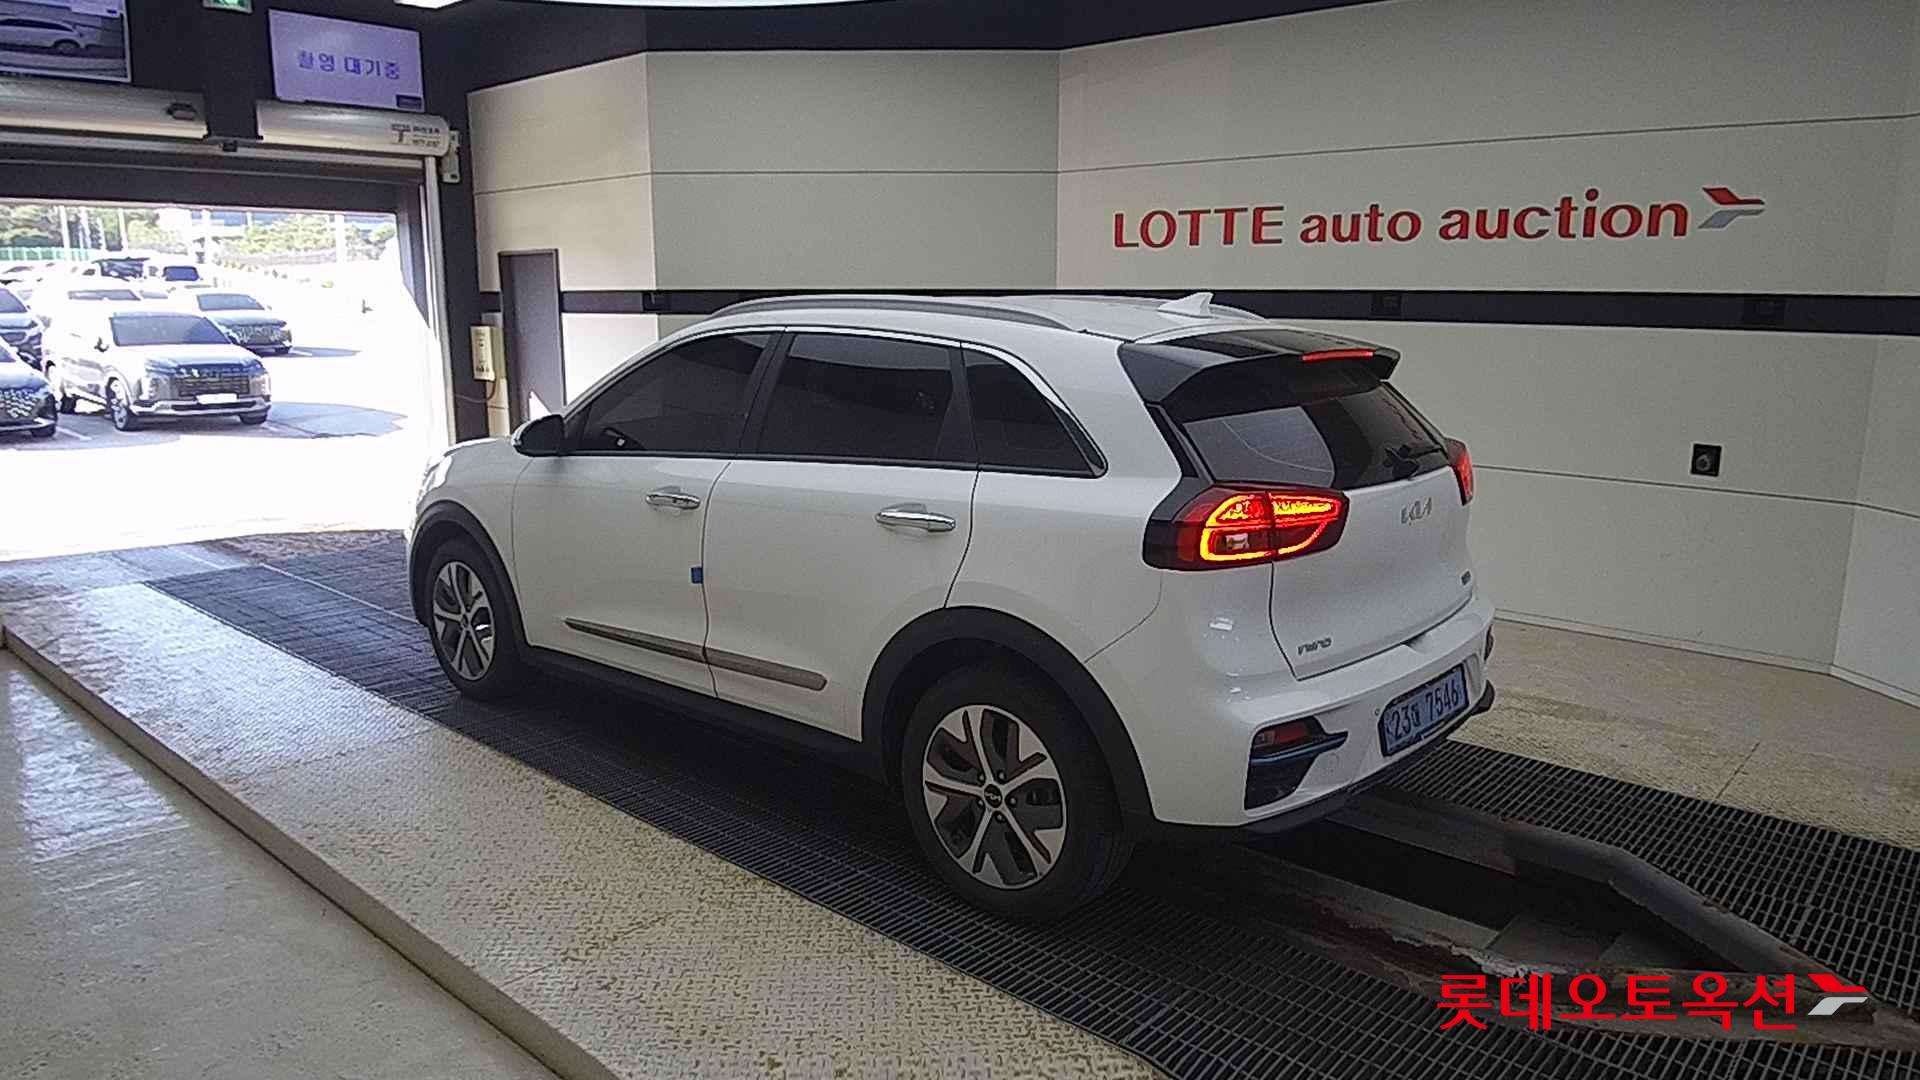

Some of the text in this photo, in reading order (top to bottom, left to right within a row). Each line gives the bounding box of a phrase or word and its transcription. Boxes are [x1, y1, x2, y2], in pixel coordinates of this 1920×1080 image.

[344, 56, 400, 80] 대기중
[1114, 188, 1687, 248] LOTTE auto auction
[1425, 680, 1459, 721] 7546
